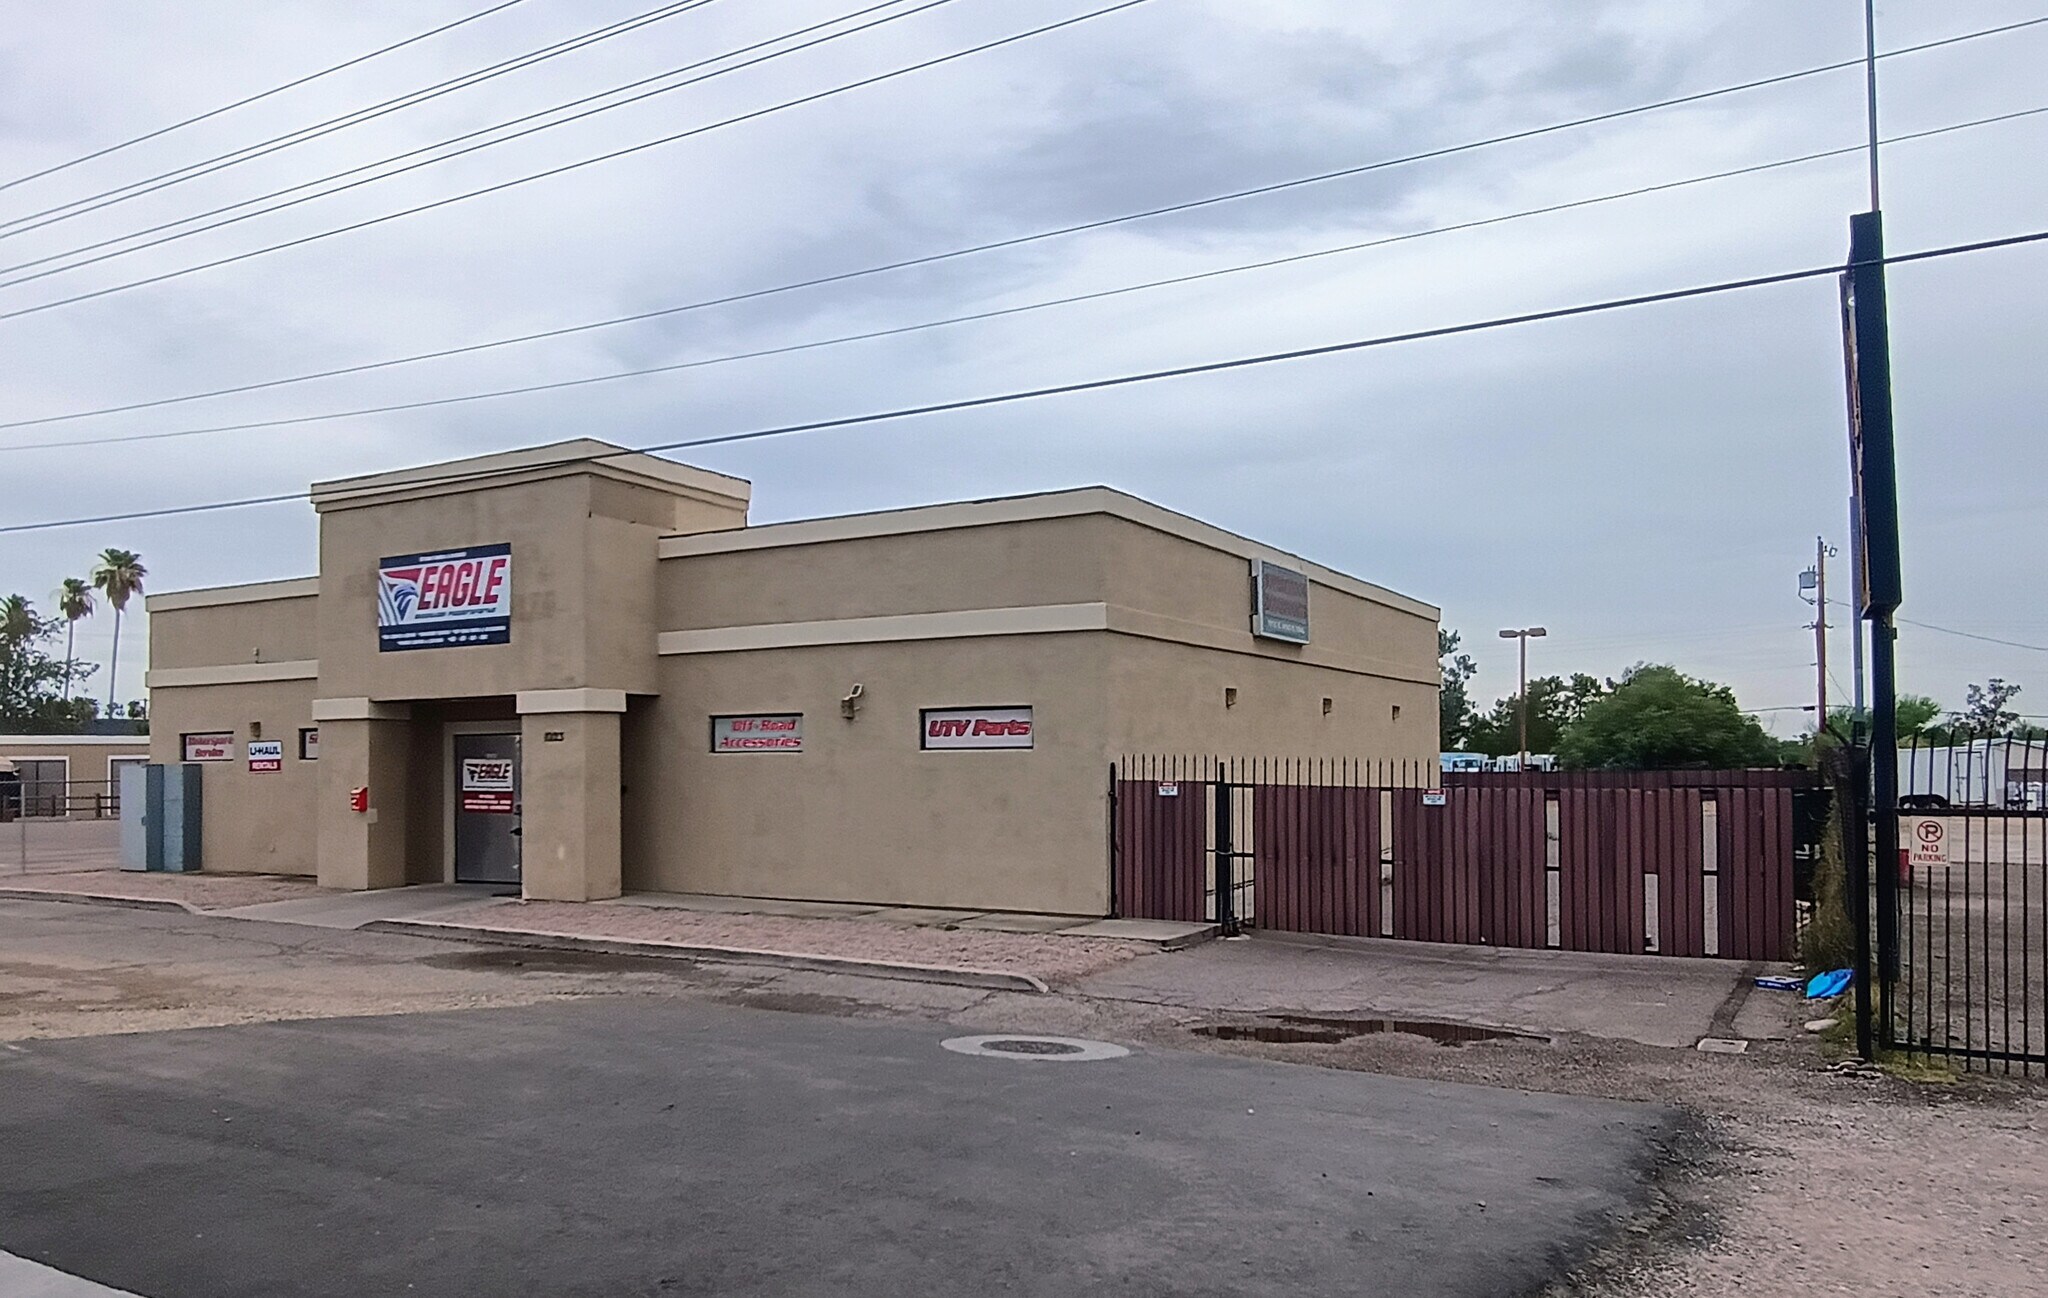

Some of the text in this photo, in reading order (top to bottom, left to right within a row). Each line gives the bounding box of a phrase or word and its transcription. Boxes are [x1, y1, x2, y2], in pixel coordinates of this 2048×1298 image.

[417, 558, 507, 611] EAGLE
[928, 719, 1032, 737] UTV Parts
[721, 737, 801, 748] Accessories
[1921, 844, 1939, 853] NO
[1913, 853, 1947, 862] PARKING
